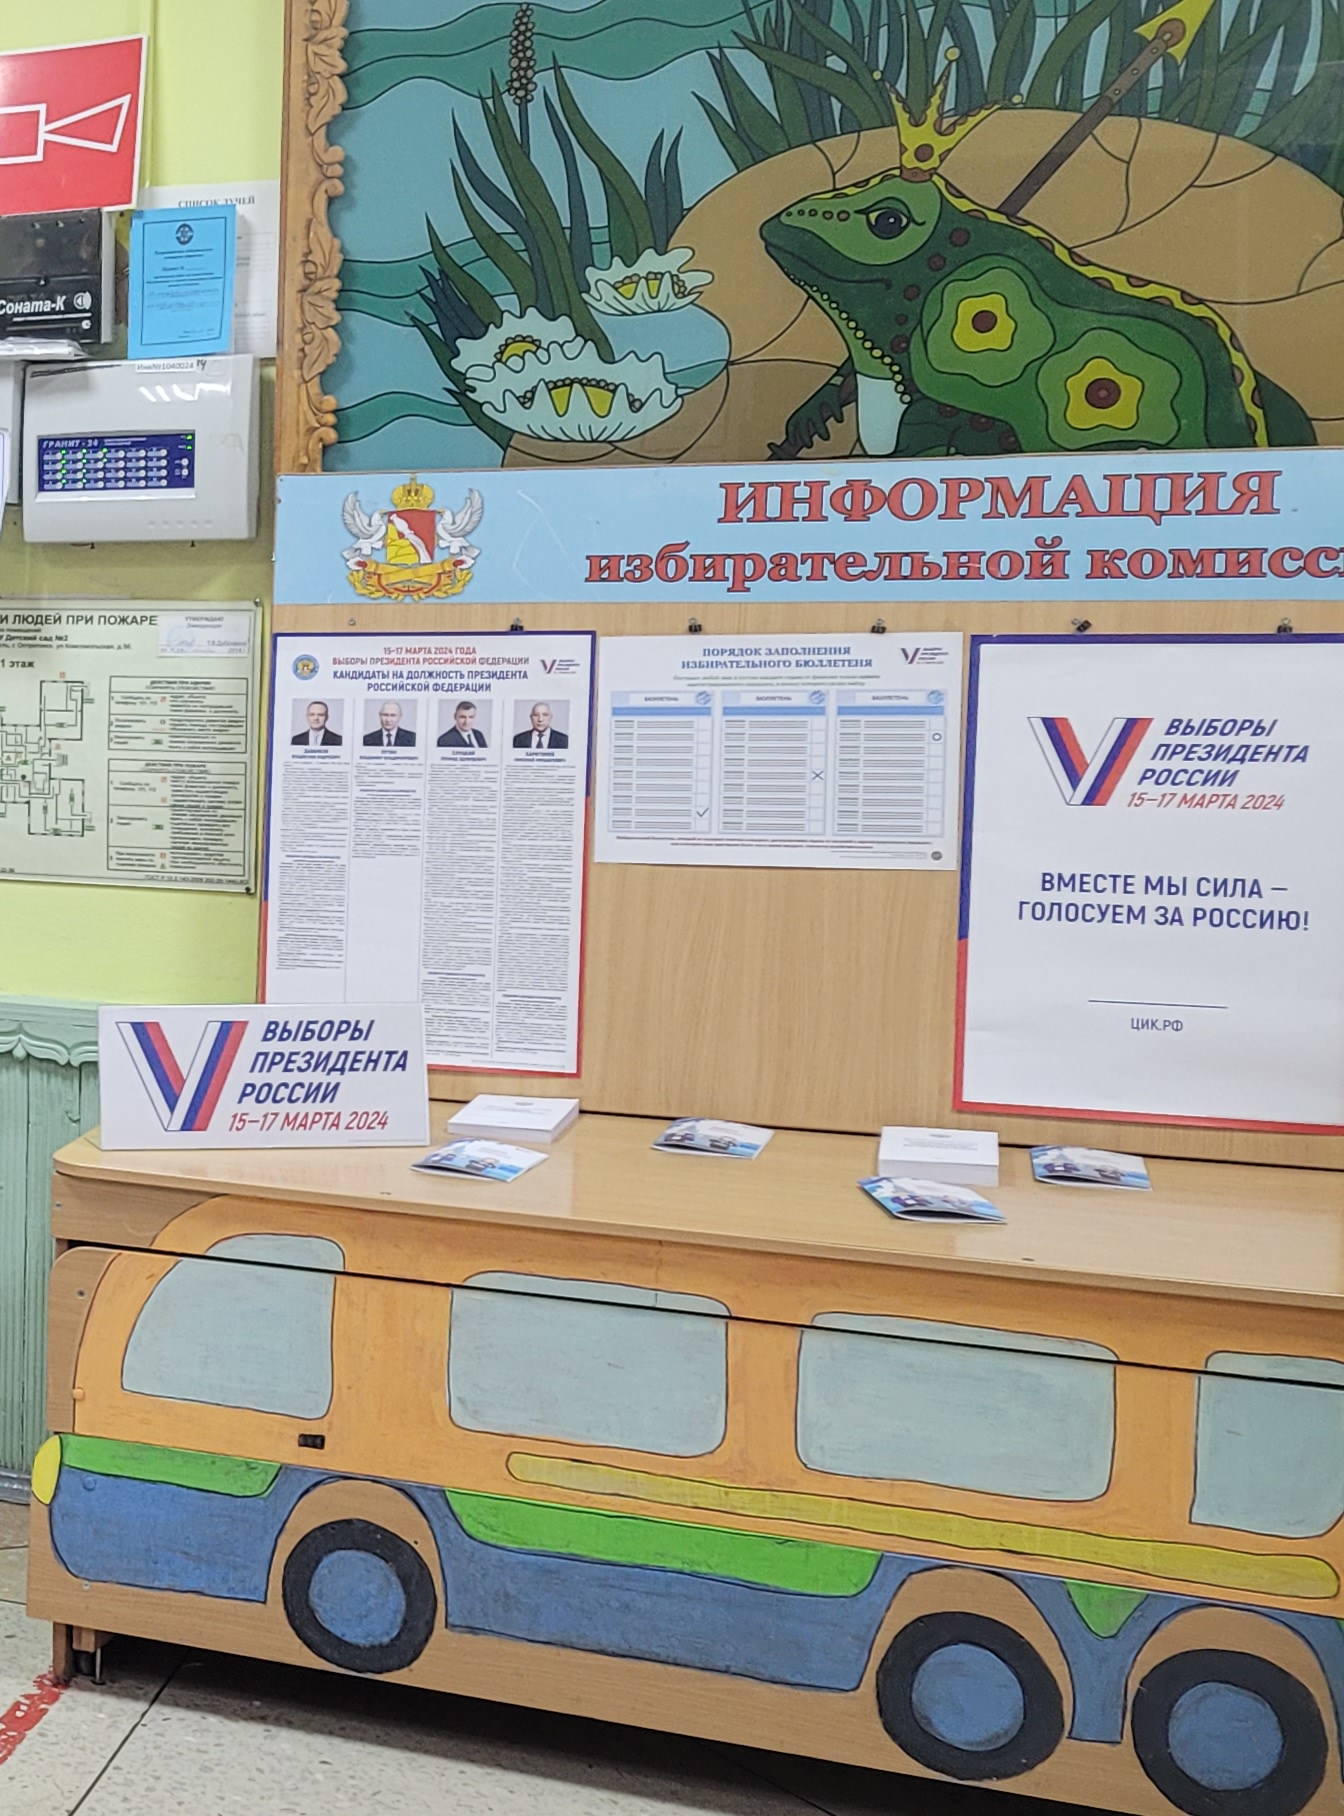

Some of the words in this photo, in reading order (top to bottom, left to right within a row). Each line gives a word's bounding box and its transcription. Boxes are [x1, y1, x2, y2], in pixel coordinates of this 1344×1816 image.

[717, 470, 1282, 526] ИНФОРМАЦИЯ
[584, 535, 1070, 593] избирательной
[1085, 545, 1344, 579] комисс
[12, 612, 62, 626] ЛЮДЕЙ
[66, 615, 94, 625] ПРИ
[98, 614, 158, 626] ПОЖАРЕ
[405, 647, 432, 655] МАРТА
[455, 646, 477, 655] ГОДА
[702, 647, 762, 658] ПОРЯДОК
[765, 646, 851, 656] ЗАПОЛНЕНИЯ
[0, 658, 5, 667] 1
[9, 660, 34, 668] этаж
[332, 657, 368, 666] ВЫБОРЫ
[370, 657, 421, 666] ПРЕЗИДЕНТА
[422, 655, 477, 665] РОССИЙСКОЙ
[479, 657, 530, 666] ФЕДЕРАЦИИ
[681, 659, 792, 669] ИЗБИРАТЕЛЬНОГО
[795, 658, 873, 669] БЮЛЛЕТЕНЯ
[333, 670, 390, 681] КАНДИДАТЫ
[392, 670, 404, 680] НА
[406, 670, 465, 681] ДОЛЖНОСТЬ
[467, 670, 529, 681] ПРЕЗИДЕНТА
[367, 680, 430, 692] РОССИЙСКОЙ
[432, 682, 492, 693] ФЕДЕРАЦИИ
[1164, 718, 1279, 737] ВЫБОРЫ
[1150, 743, 1310, 765] ПРЕЗИДЕНТА
[1137, 768, 1240, 787] РОССИИ
[1177, 793, 1239, 810] МАРТА
[1240, 794, 1285, 810] 2024
[1041, 872, 1136, 895] ВМЕСТЕ
[1144, 875, 1187, 897] МЫ
[1196, 876, 1264, 899] СИЛА
[1018, 900, 1146, 925] ГОЛОСУЕМ
[1154, 905, 1185, 927] ЗА
[1193, 906, 1310, 932] РОССИЮ!
[261, 1019, 375, 1042] ВЫБОРЫ
[1131, 1017, 1184, 1032] ЦИК.РФ
[249, 1050, 409, 1076] ПРЕЗИДЕНТА
[237, 1082, 341, 1104] РОССИИ
[280, 1111, 342, 1131] МАРТА
[344, 1110, 389, 1130] 2024
